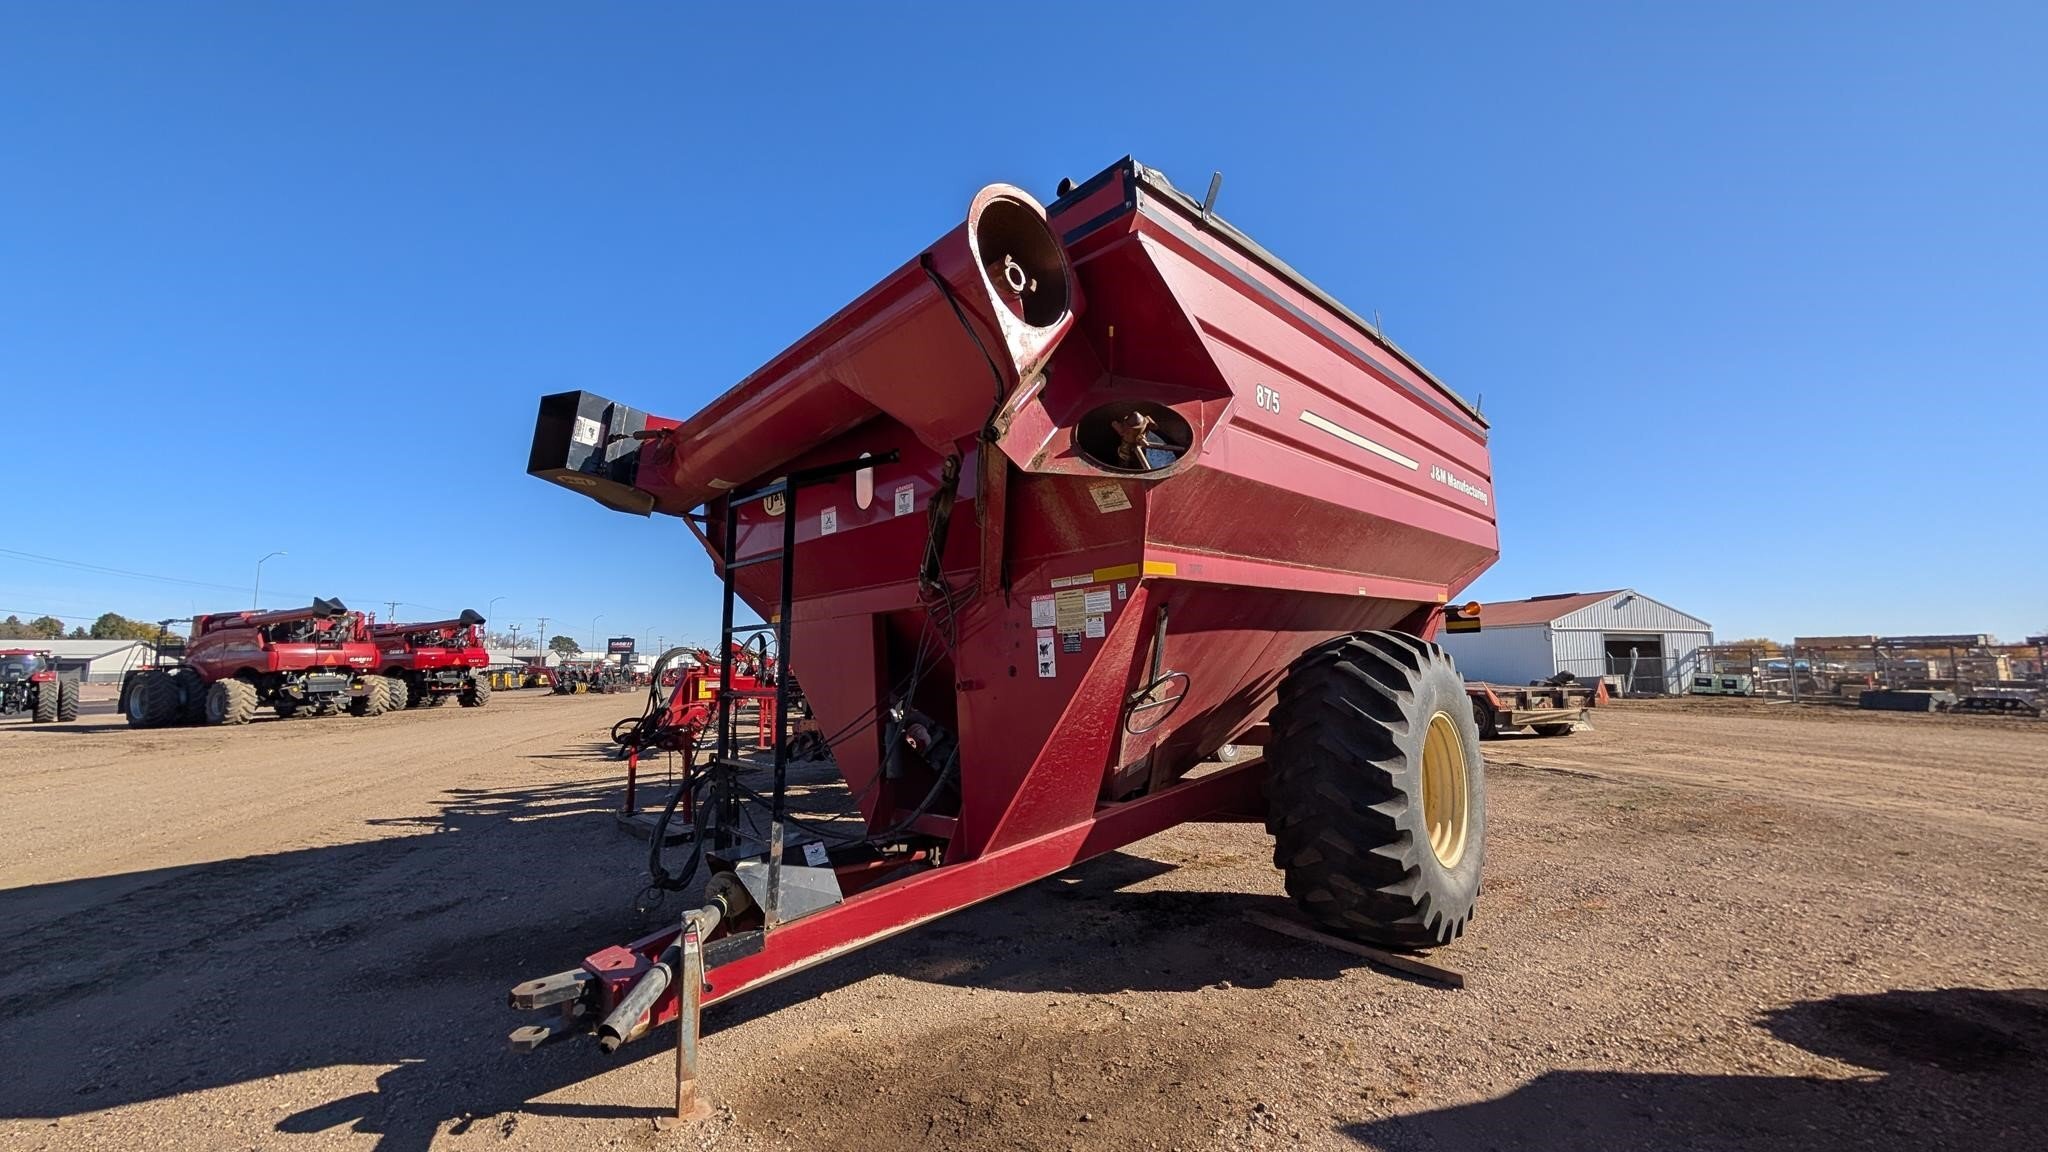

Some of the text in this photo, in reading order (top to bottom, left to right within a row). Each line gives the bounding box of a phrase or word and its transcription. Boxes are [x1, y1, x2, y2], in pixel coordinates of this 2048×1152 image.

[1256, 384, 1280, 415] 875
[1430, 464, 1488, 506] J&M Manufacturing
